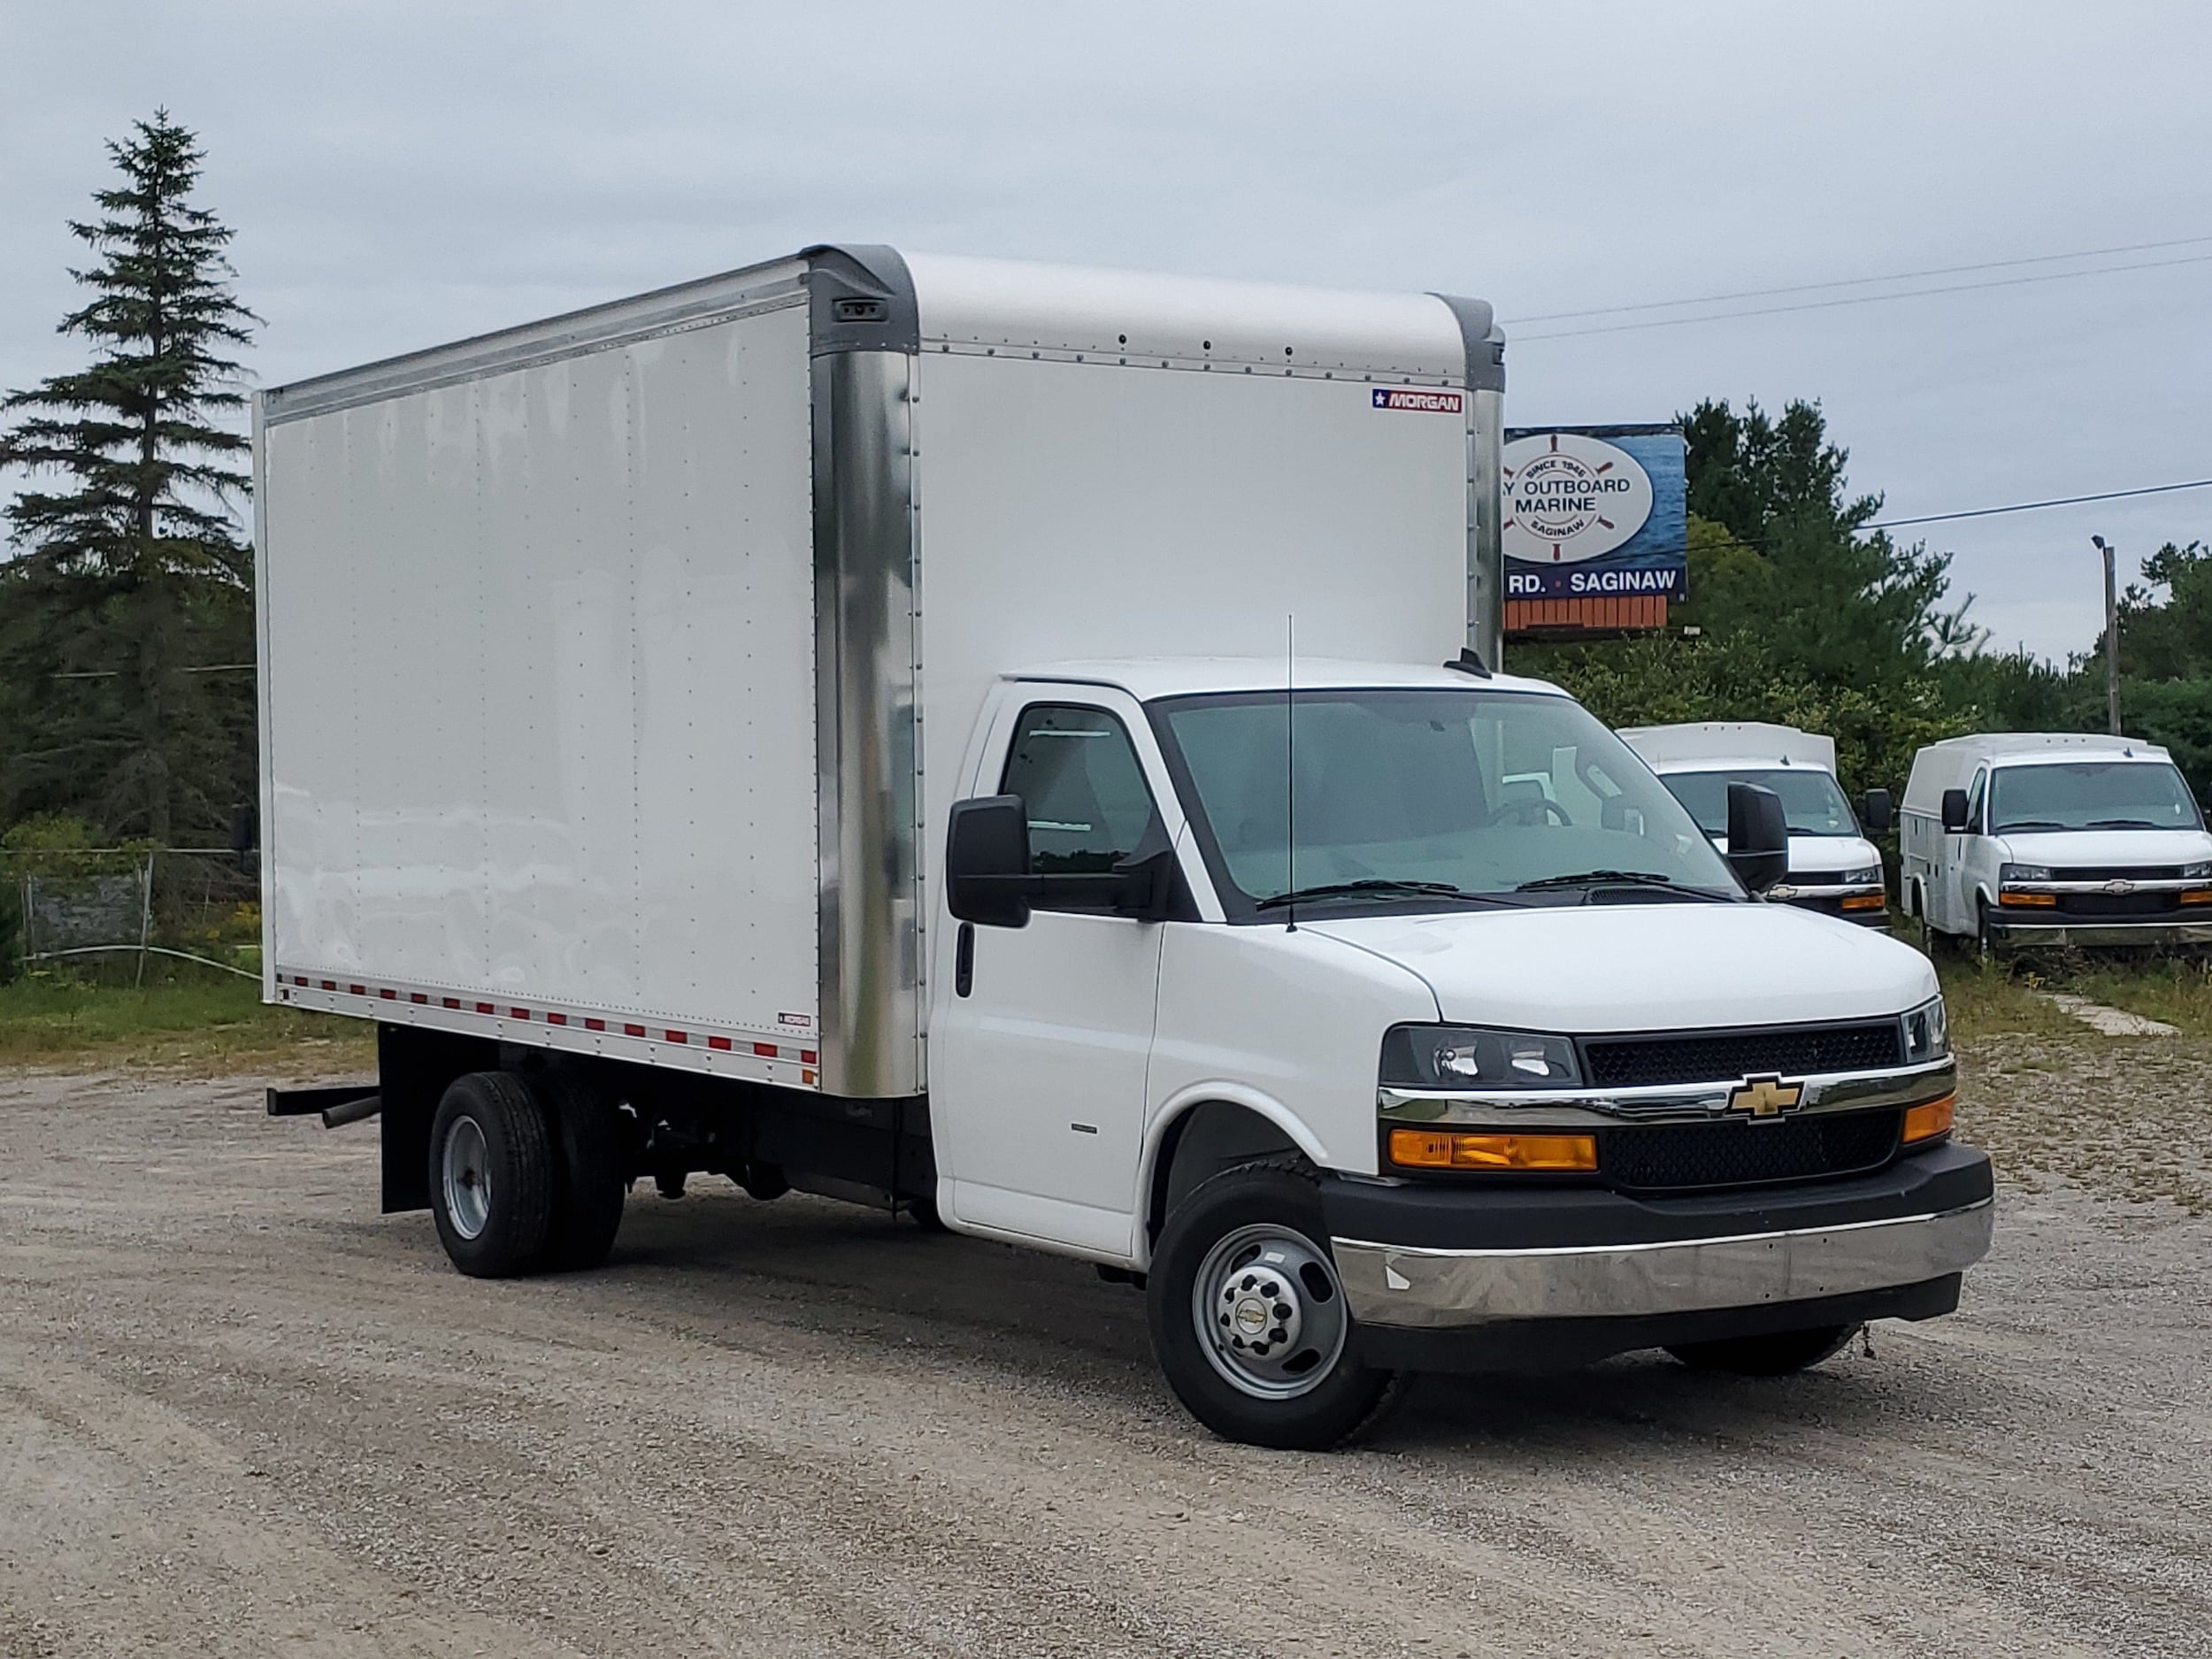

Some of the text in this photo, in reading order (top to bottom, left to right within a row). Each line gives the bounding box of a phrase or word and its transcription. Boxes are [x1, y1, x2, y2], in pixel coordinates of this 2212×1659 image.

[1388, 393, 1460, 411] MORGAN
[1525, 460, 1557, 479] SINCE
[1502, 479, 1631, 495] Y OUTBOARD
[1515, 497, 1596, 513] MARINE
[1530, 519, 1586, 537] SAGINAW
[1508, 570, 1677, 594] RD. SAGINAW
